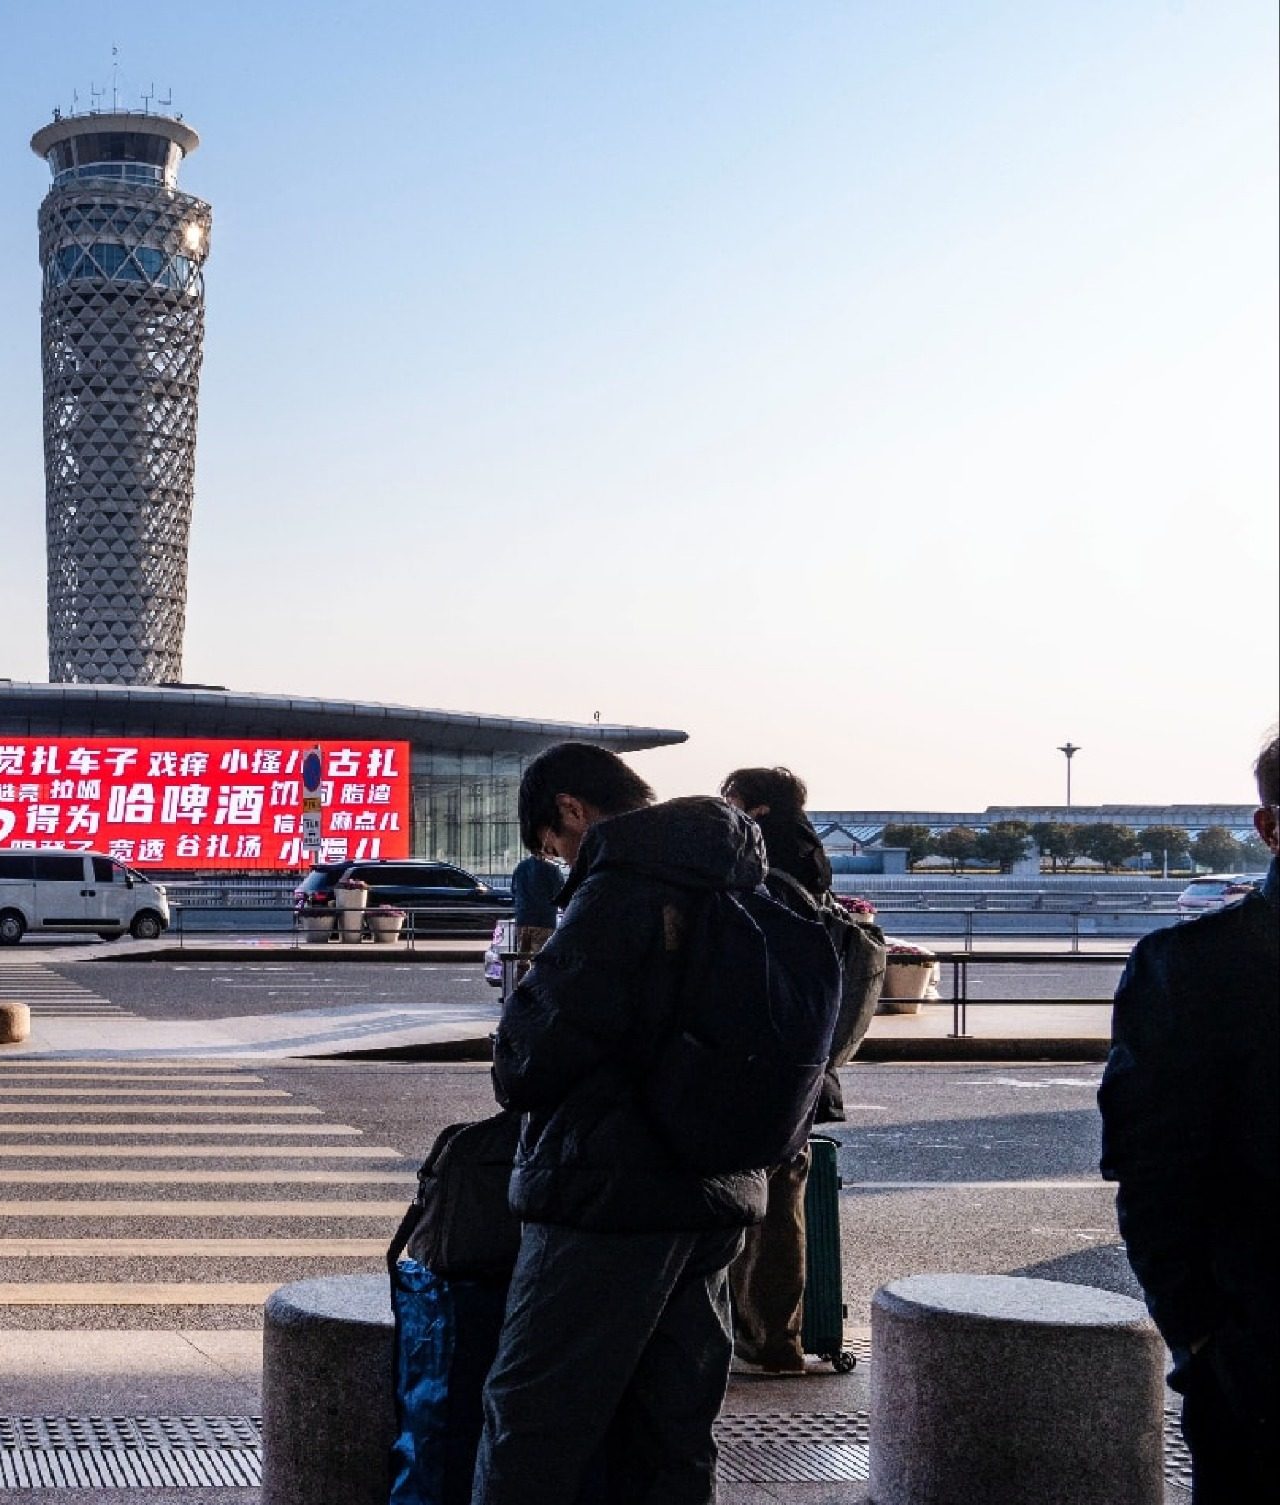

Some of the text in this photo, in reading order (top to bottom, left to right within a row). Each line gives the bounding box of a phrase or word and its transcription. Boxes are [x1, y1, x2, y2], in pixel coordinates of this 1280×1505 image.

[147, 752, 209, 776] 戏痒
[328, 748, 398, 777] 古扎
[107, 783, 265, 825] 哈啤酒
[341, 783, 391, 804] 脂渣
[25, 804, 100, 834] 得为
[177, 834, 261, 858] 谷扎汤
